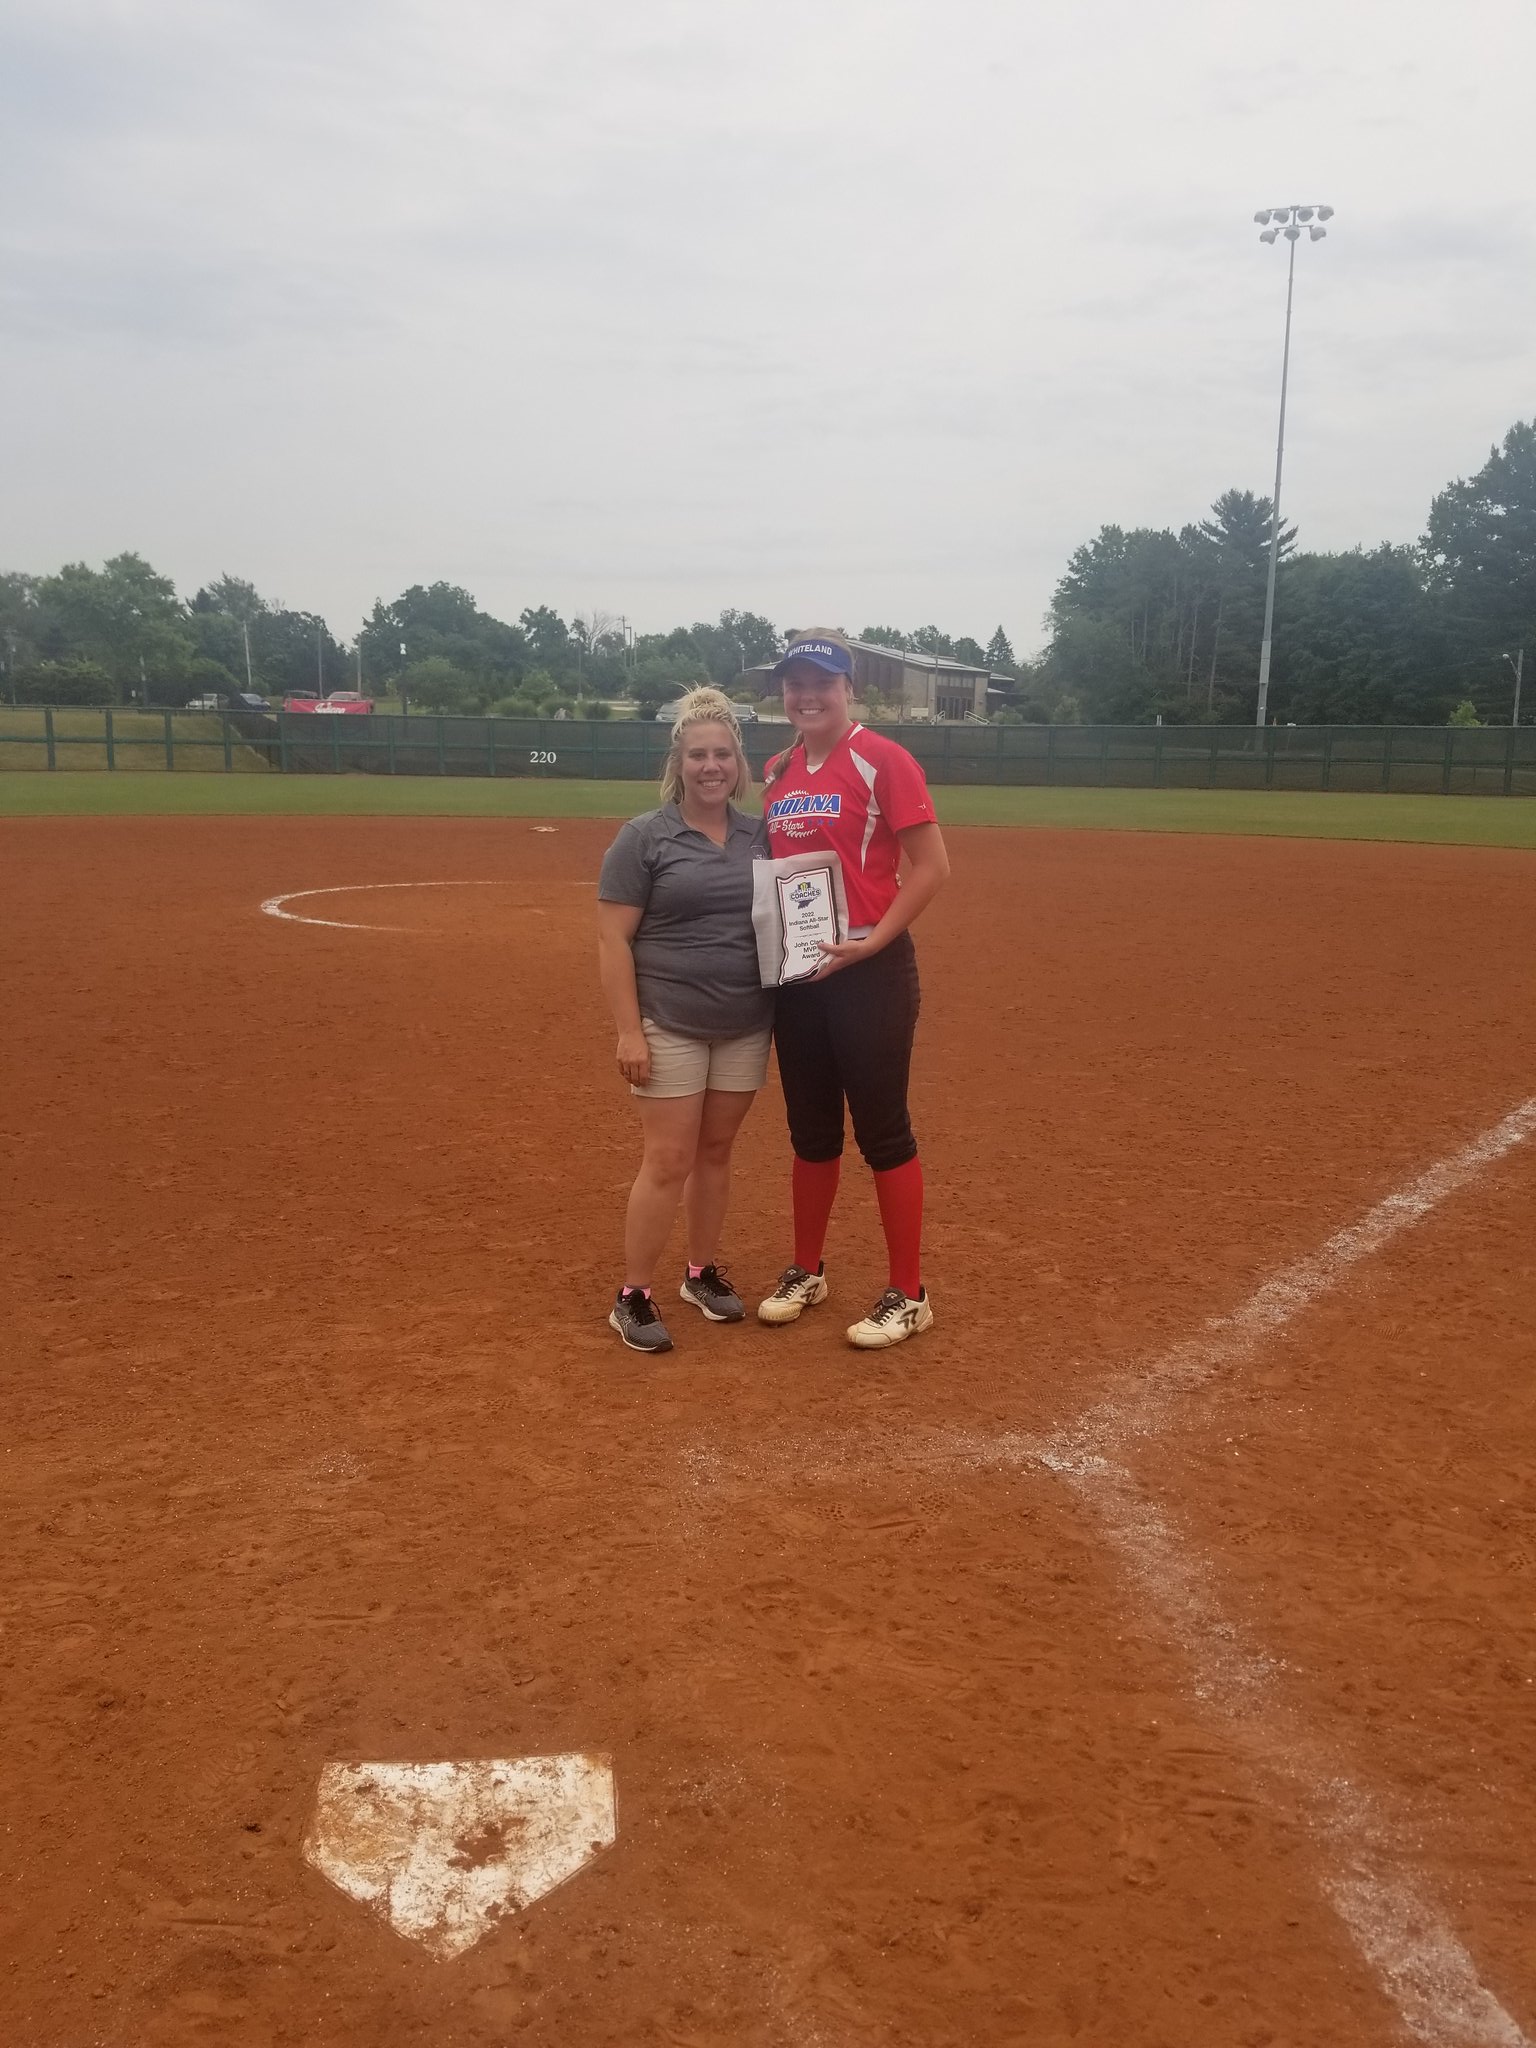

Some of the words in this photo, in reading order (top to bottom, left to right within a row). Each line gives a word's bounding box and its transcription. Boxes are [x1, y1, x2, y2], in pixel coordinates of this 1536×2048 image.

[787, 644, 832, 658] WHITELAND
[530, 751, 557, 764] 220
[767, 794, 842, 820] INDIANA
[790, 889, 820, 900] COACHES
[788, 919, 808, 927] Indiana
[809, 916, 829, 924] All-Star
[799, 923, 820, 931] Softball
[803, 945, 817, 953] MVP
[801, 952, 821, 960] Award
